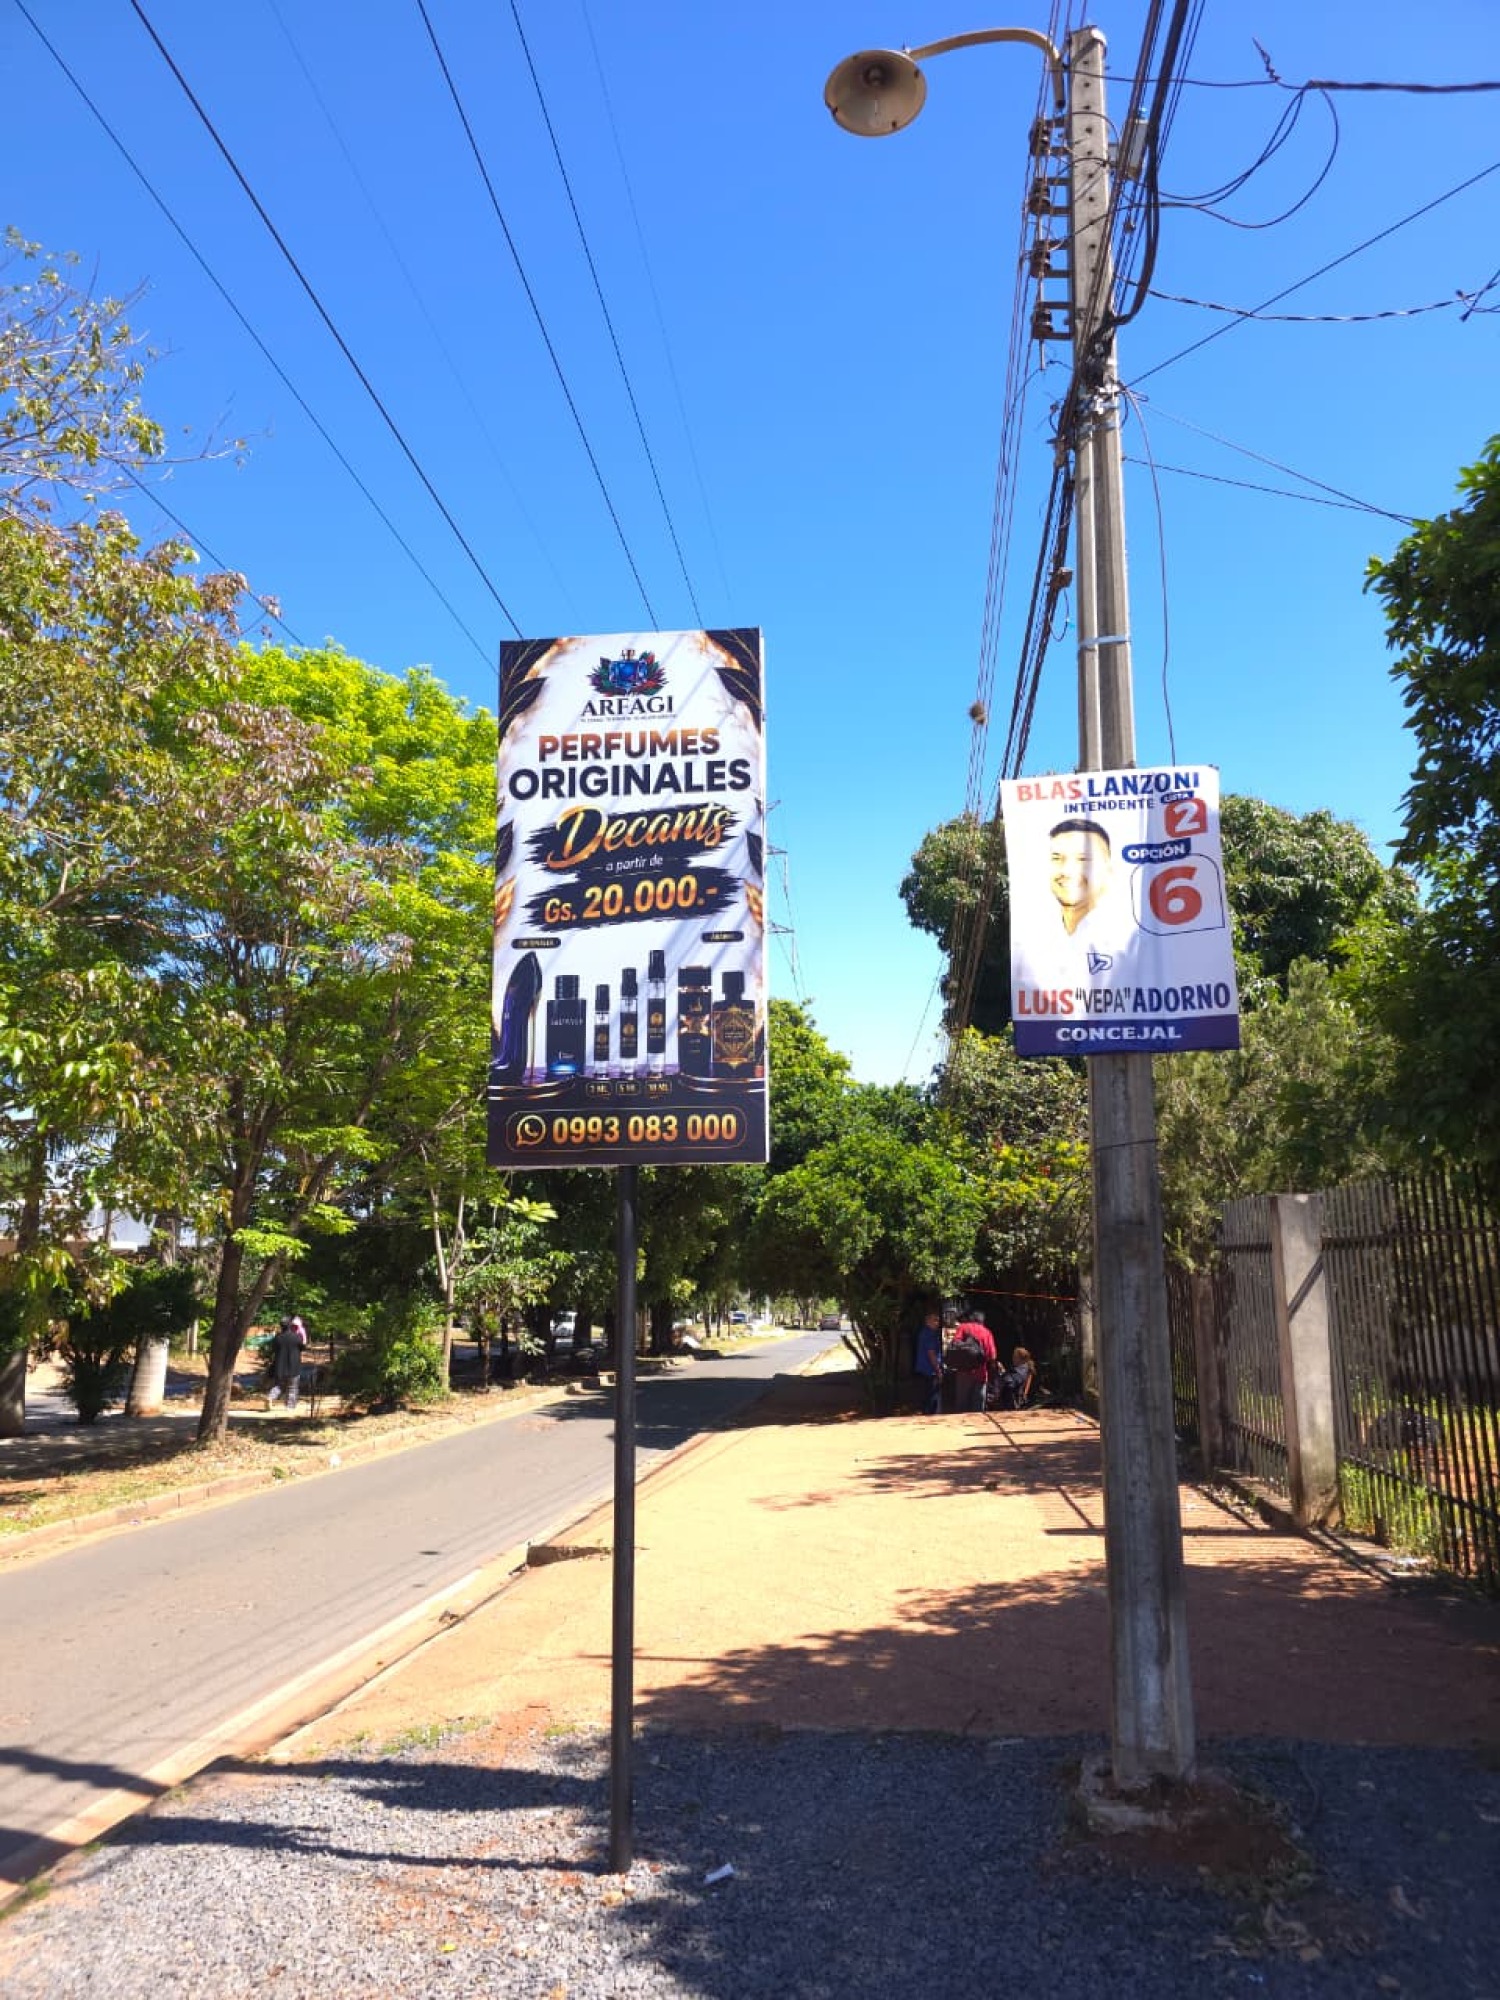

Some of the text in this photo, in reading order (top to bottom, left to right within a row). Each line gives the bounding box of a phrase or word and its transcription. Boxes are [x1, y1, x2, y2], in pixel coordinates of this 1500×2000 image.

[580, 695, 674, 717] ARFAGI
[538, 728, 721, 763] PERFUMES
[508, 759, 751, 801] ORIGINALES
[1016, 772, 1200, 802] BLAS LANZONI
[1063, 797, 1155, 814] INTENDENTE
[1173, 802, 1201, 833] 2
[546, 803, 732, 869] Decants
[605, 855, 663, 874] a partir de
[1127, 845, 1186, 860] OPCIÓN
[544, 898, 577, 924] Gs.
[1150, 866, 1203, 926] 6
[1017, 988, 1075, 1015] LUIS
[1132, 982, 1231, 1013] ADORNO
[1055, 1024, 1182, 1042] CONCEJAL
[552, 1113, 737, 1144] 0993 083 000
